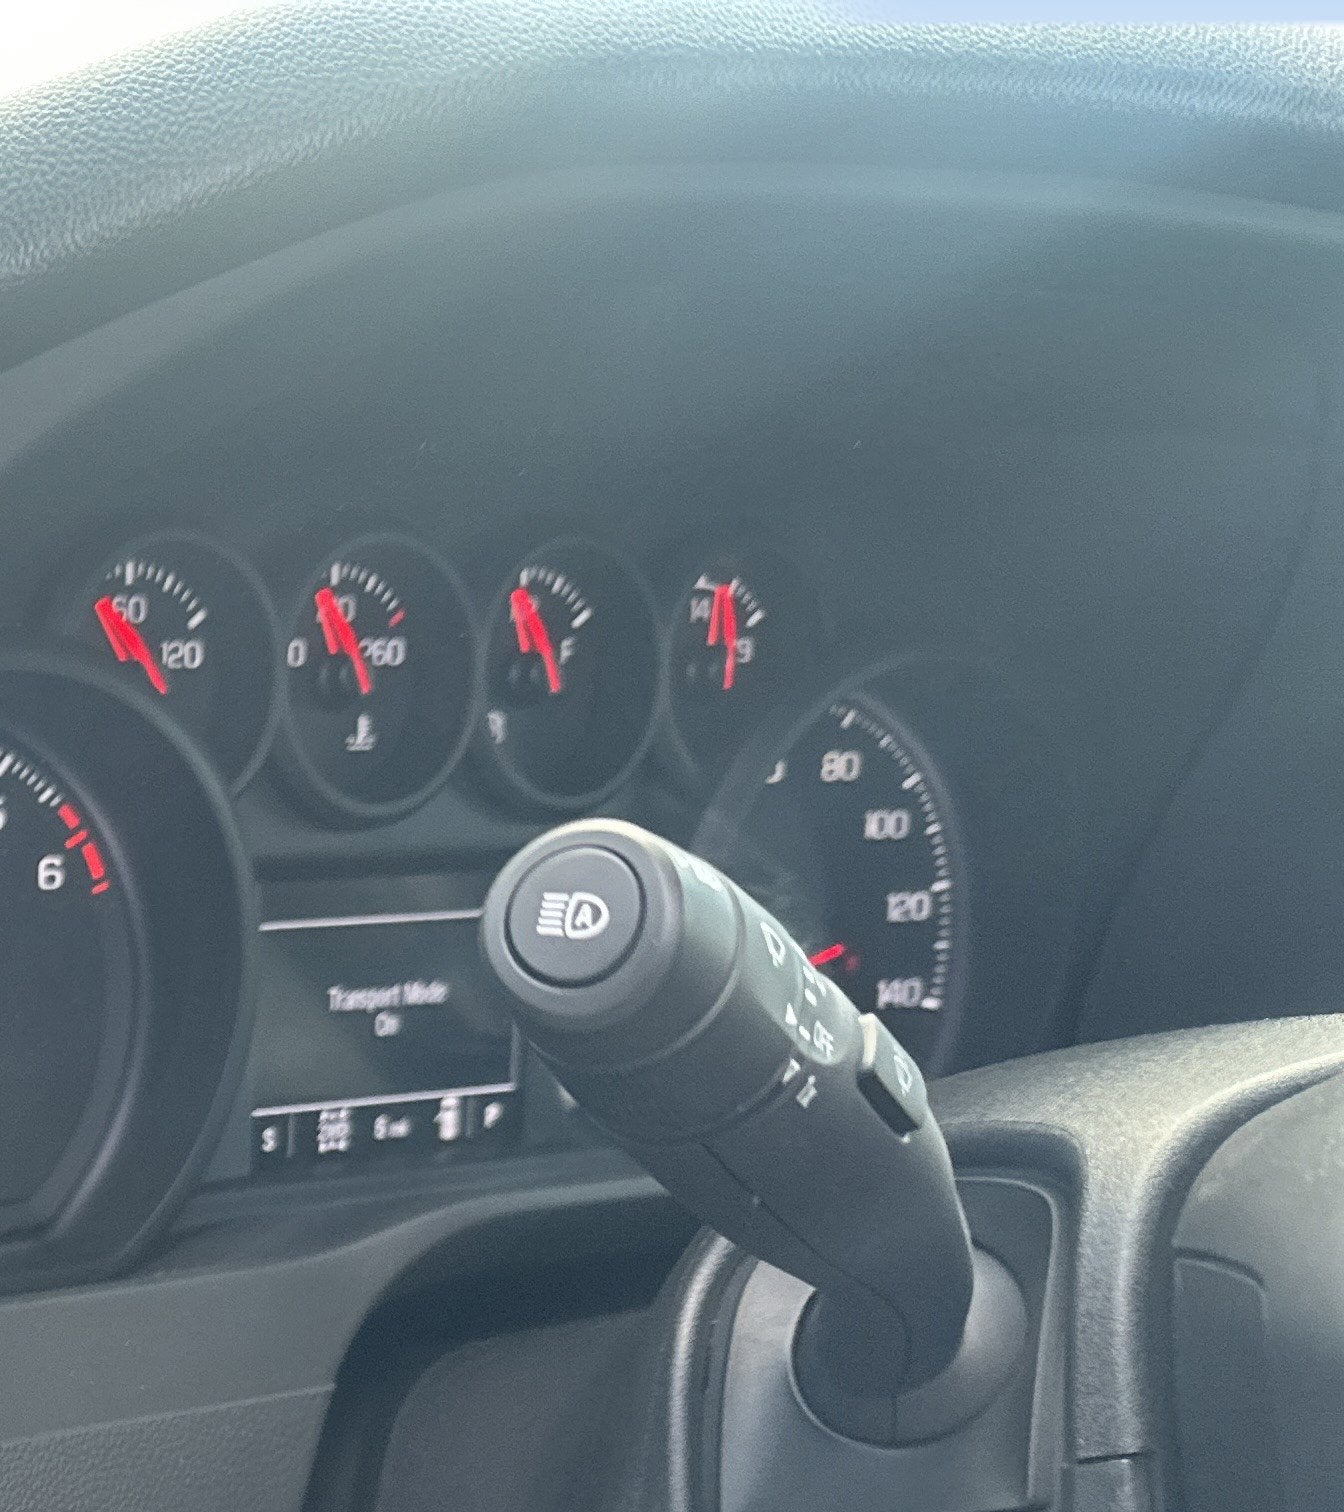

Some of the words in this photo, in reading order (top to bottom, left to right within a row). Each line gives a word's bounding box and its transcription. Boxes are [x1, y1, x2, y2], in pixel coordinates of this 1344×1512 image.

[160, 639, 204, 669] 120
[286, 637, 308, 667] 0
[819, 749, 863, 783] 80
[864, 808, 910, 841] 100
[36, 853, 65, 891] 6
[886, 891, 933, 924] 120
[877, 976, 925, 1010] 140
